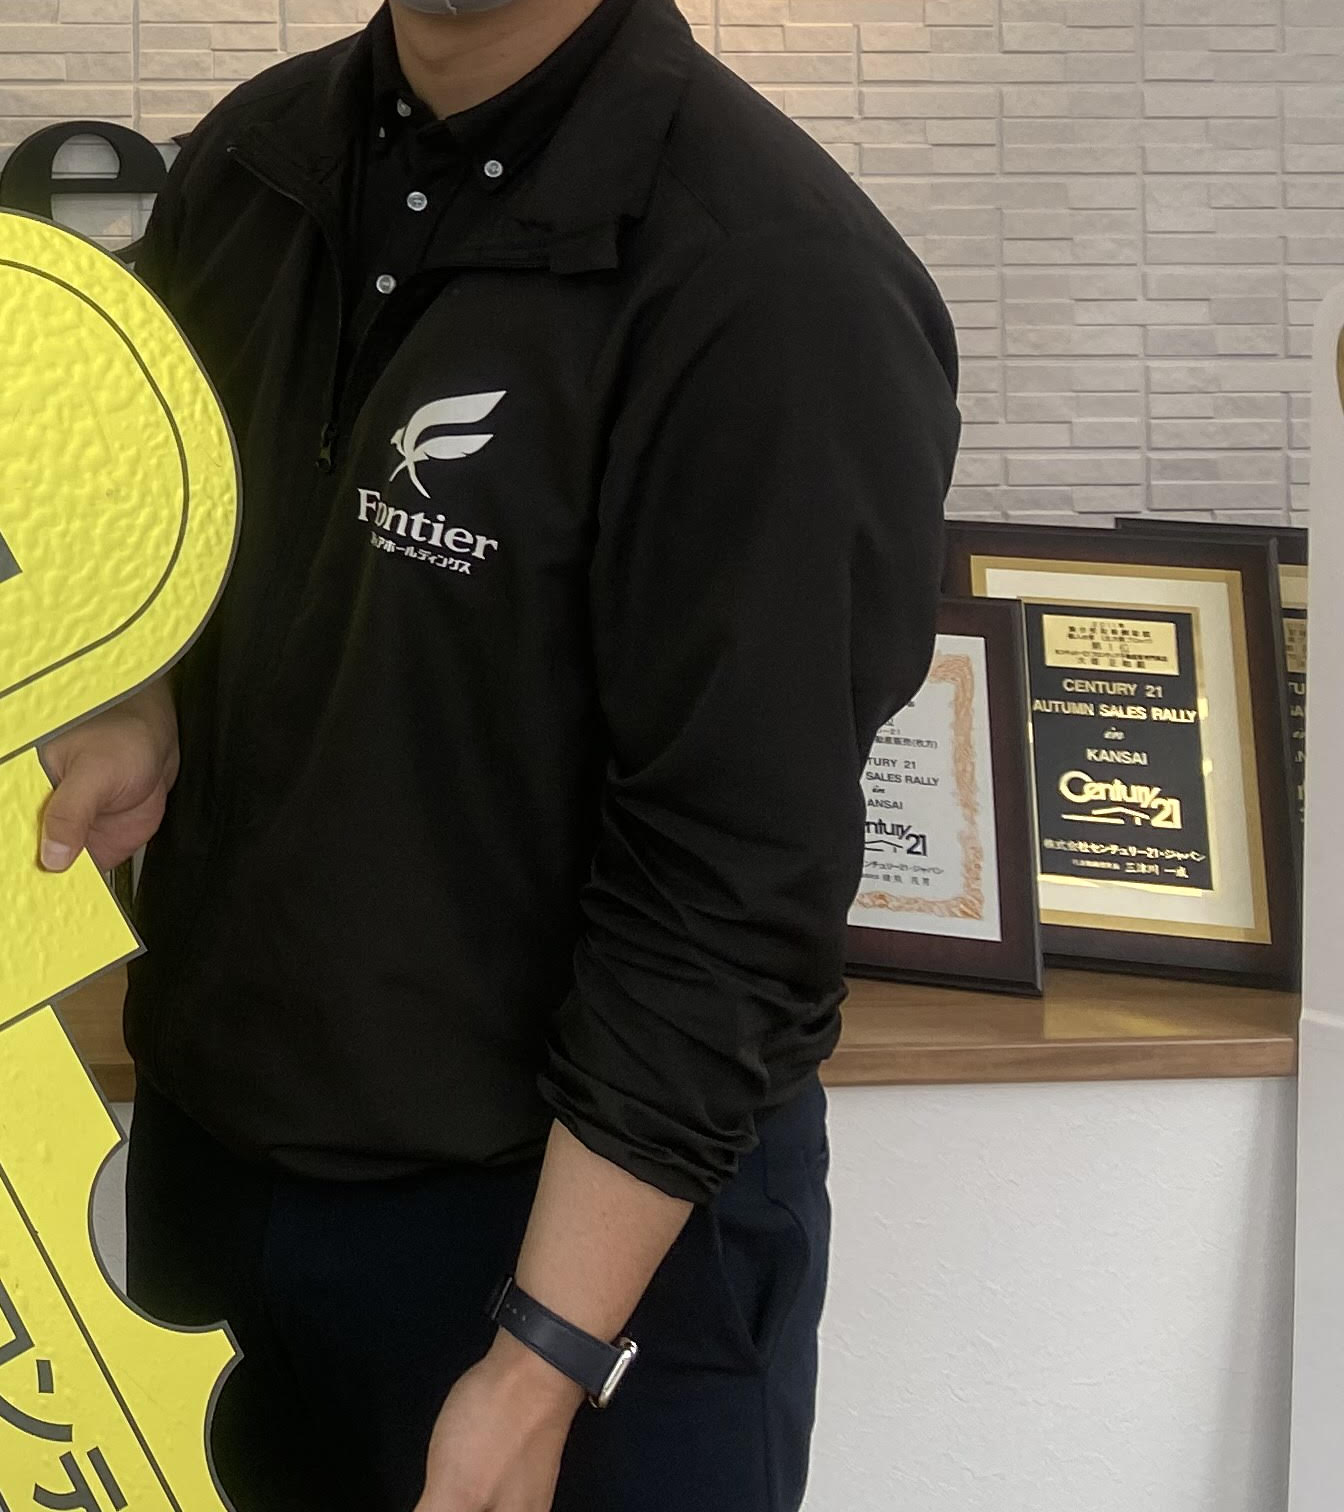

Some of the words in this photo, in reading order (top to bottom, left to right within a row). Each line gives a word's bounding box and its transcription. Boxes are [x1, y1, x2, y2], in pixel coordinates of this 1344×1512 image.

[1062, 678, 1138, 697] CENTURY
[1145, 685, 1163, 699] 21
[1032, 699, 1095, 717] AUTUMN
[1099, 703, 1148, 720] SALES
[1151, 706, 1197, 723] RALLY
[867, 756, 898, 768] TURY
[904, 760, 917, 769] 21
[1085, 748, 1150, 766] KANSAI
[865, 771, 902, 783] SALES
[905, 774, 940, 787] RALLY
[867, 798, 904, 810] ANSAI
[1059, 770, 1161, 808] Century
[1150, 797, 1183, 829] 21
[865, 818, 913, 840] ntury
[905, 833, 928, 857] 21
